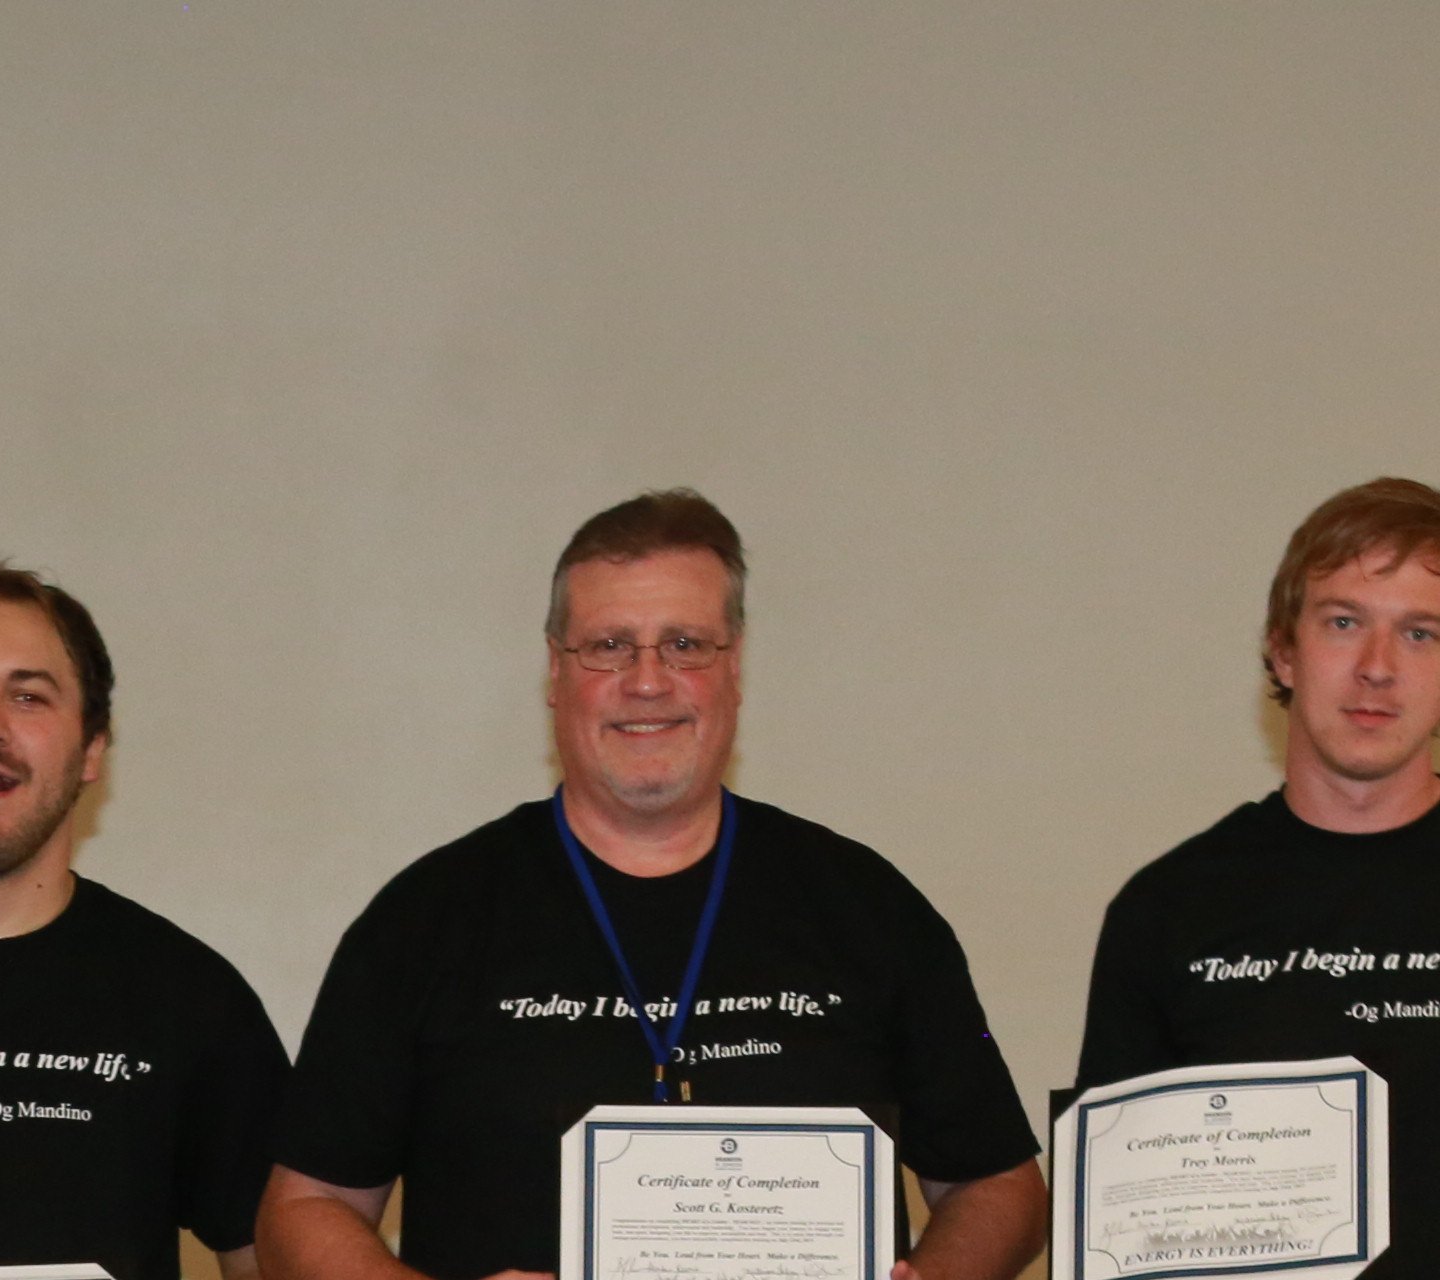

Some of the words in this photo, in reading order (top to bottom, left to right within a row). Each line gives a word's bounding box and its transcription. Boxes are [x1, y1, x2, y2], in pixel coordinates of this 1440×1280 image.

[1283, 951, 1298, 971] I
[1302, 947, 1375, 977] begin
[1383, 954, 1400, 969] a
[592, 997, 607, 1016] I
[696, 1001, 710, 1015] a
[719, 997, 772, 1012] new
[1345, 1003, 1378, 1022] -Og
[702, 1039, 781, 1059] Mandino
[14, 1053, 30, 1067] a
[37, 1054, 89, 1070] new
[18, 1102, 91, 1121] Mandino
